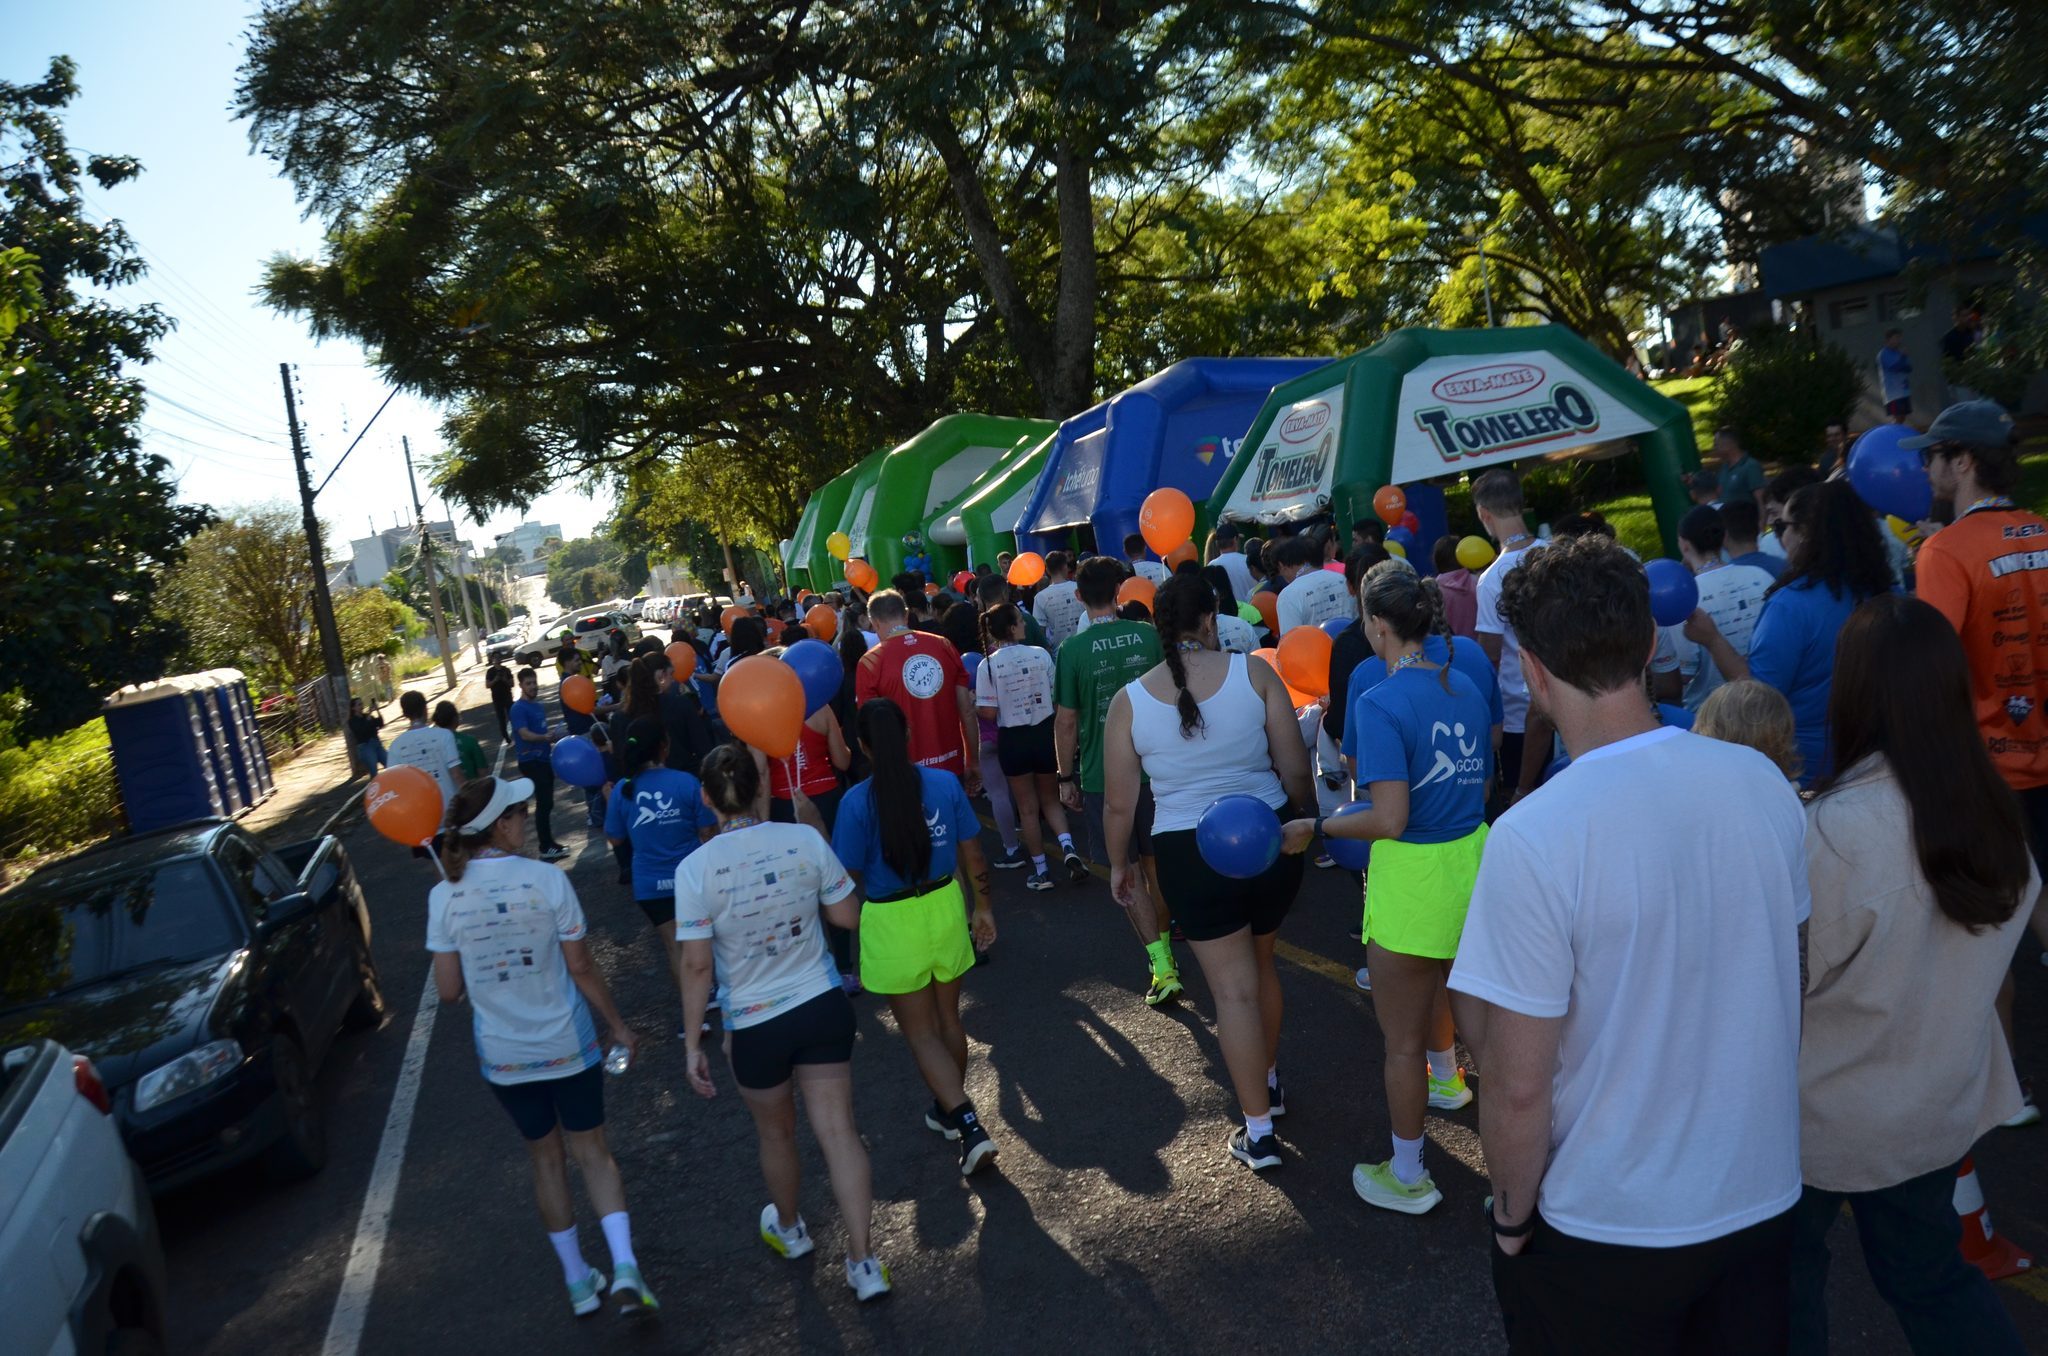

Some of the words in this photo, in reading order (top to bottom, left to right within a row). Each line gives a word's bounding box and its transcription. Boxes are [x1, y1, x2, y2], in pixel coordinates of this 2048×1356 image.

[1418, 383, 1597, 457] TOMELERO
[1255, 431, 1333, 494] TOMELERO
[1091, 633, 1143, 653] ATLETA
